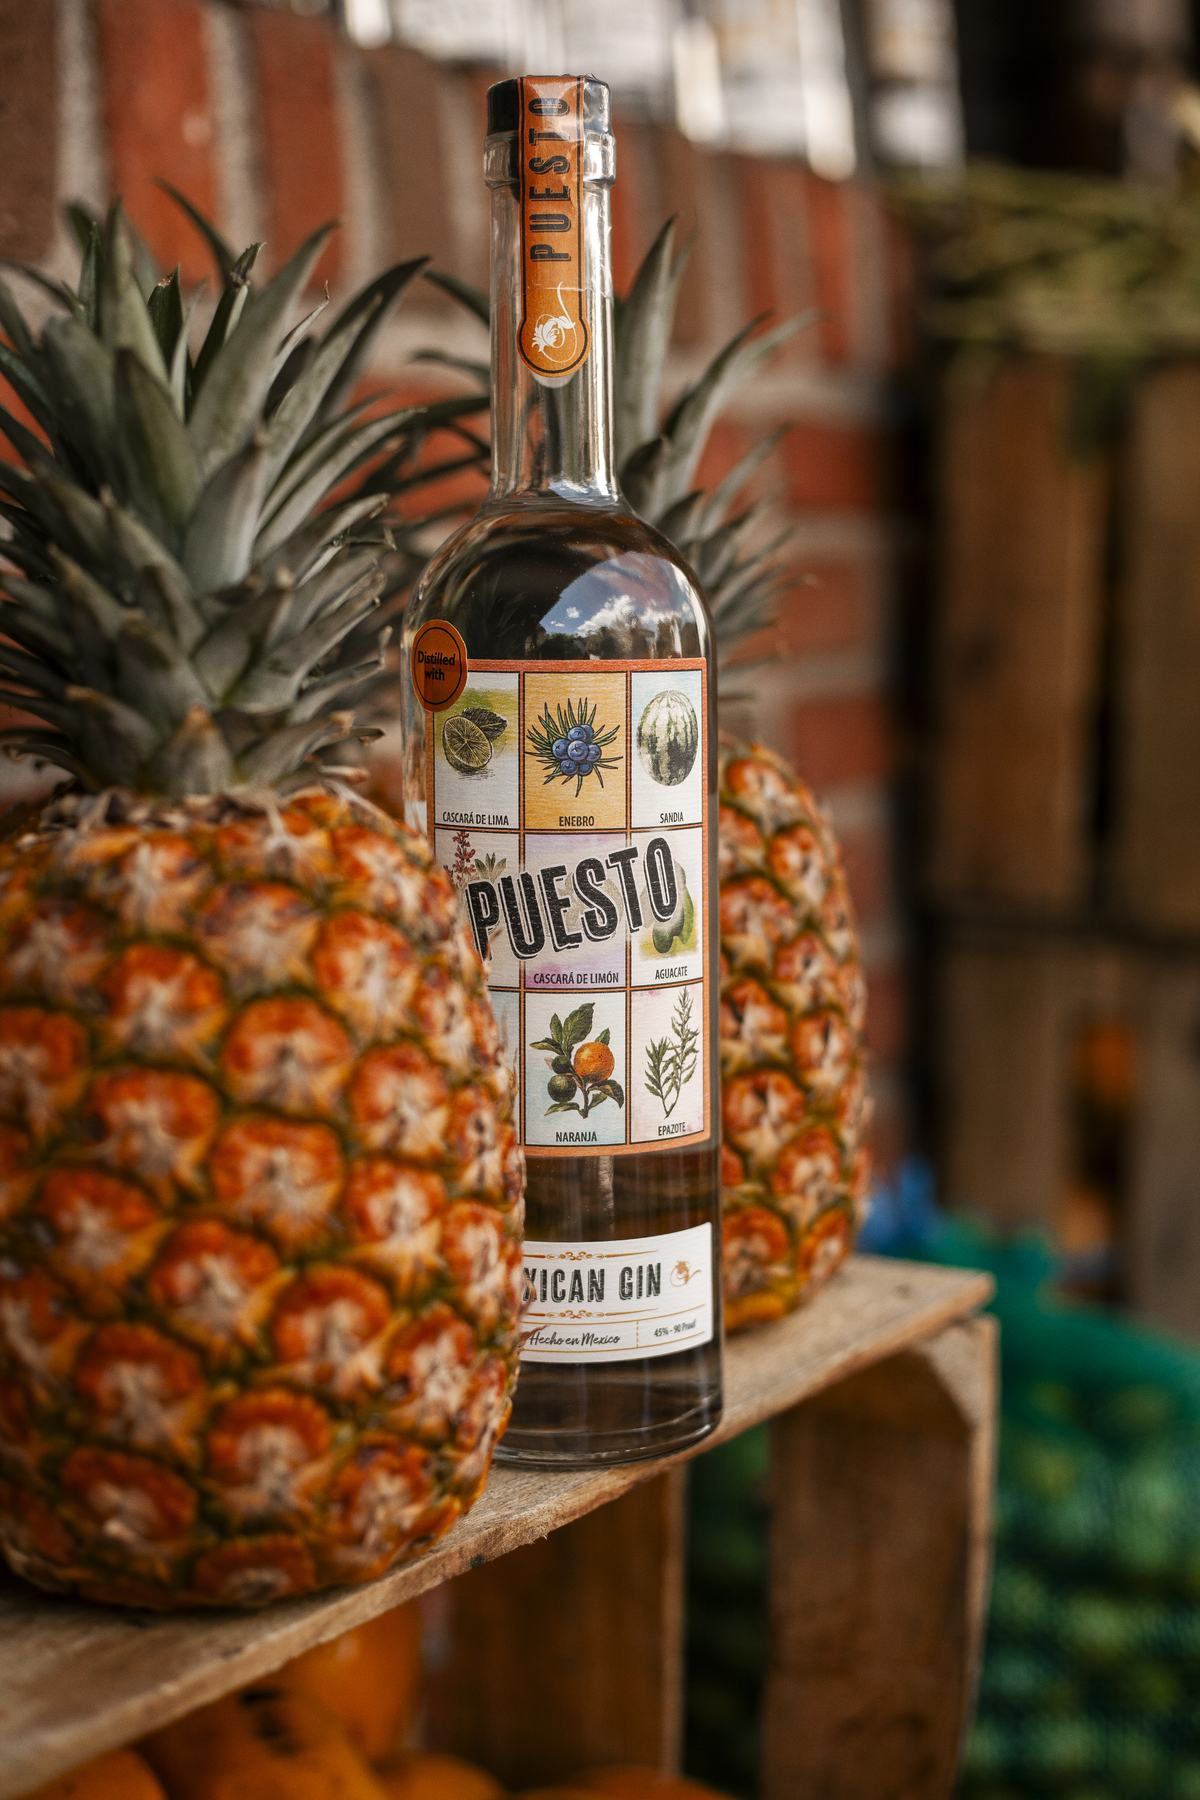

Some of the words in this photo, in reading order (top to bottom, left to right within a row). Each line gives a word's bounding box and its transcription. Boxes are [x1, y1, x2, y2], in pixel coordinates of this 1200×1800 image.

[528, 97, 571, 262] PUESTO
[417, 651, 456, 666] Distilled
[424, 668, 445, 680] with
[442, 811, 474, 824] CASCARÁ
[475, 814, 486, 825] DE
[488, 814, 509, 826] LIMA
[559, 816, 595, 827] ENEBRO
[659, 811, 684, 824] SANDIA
[466, 837, 678, 961] PUESTO
[533, 971, 575, 984] CASCARÁ
[576, 973, 588, 984] DE
[590, 970, 619, 984] LIMÓN
[655, 965, 688, 980] AGUACATE
[657, 1121, 686, 1136] EPAZOTE
[555, 1131, 598, 1143] NARANJA
[522, 1266, 605, 1303] XICAN
[618, 1262, 661, 1301] GIN
[529, 1331, 563, 1346] Hecho
[564, 1337, 580, 1346] en
[580, 1331, 622, 1346] Mexico
